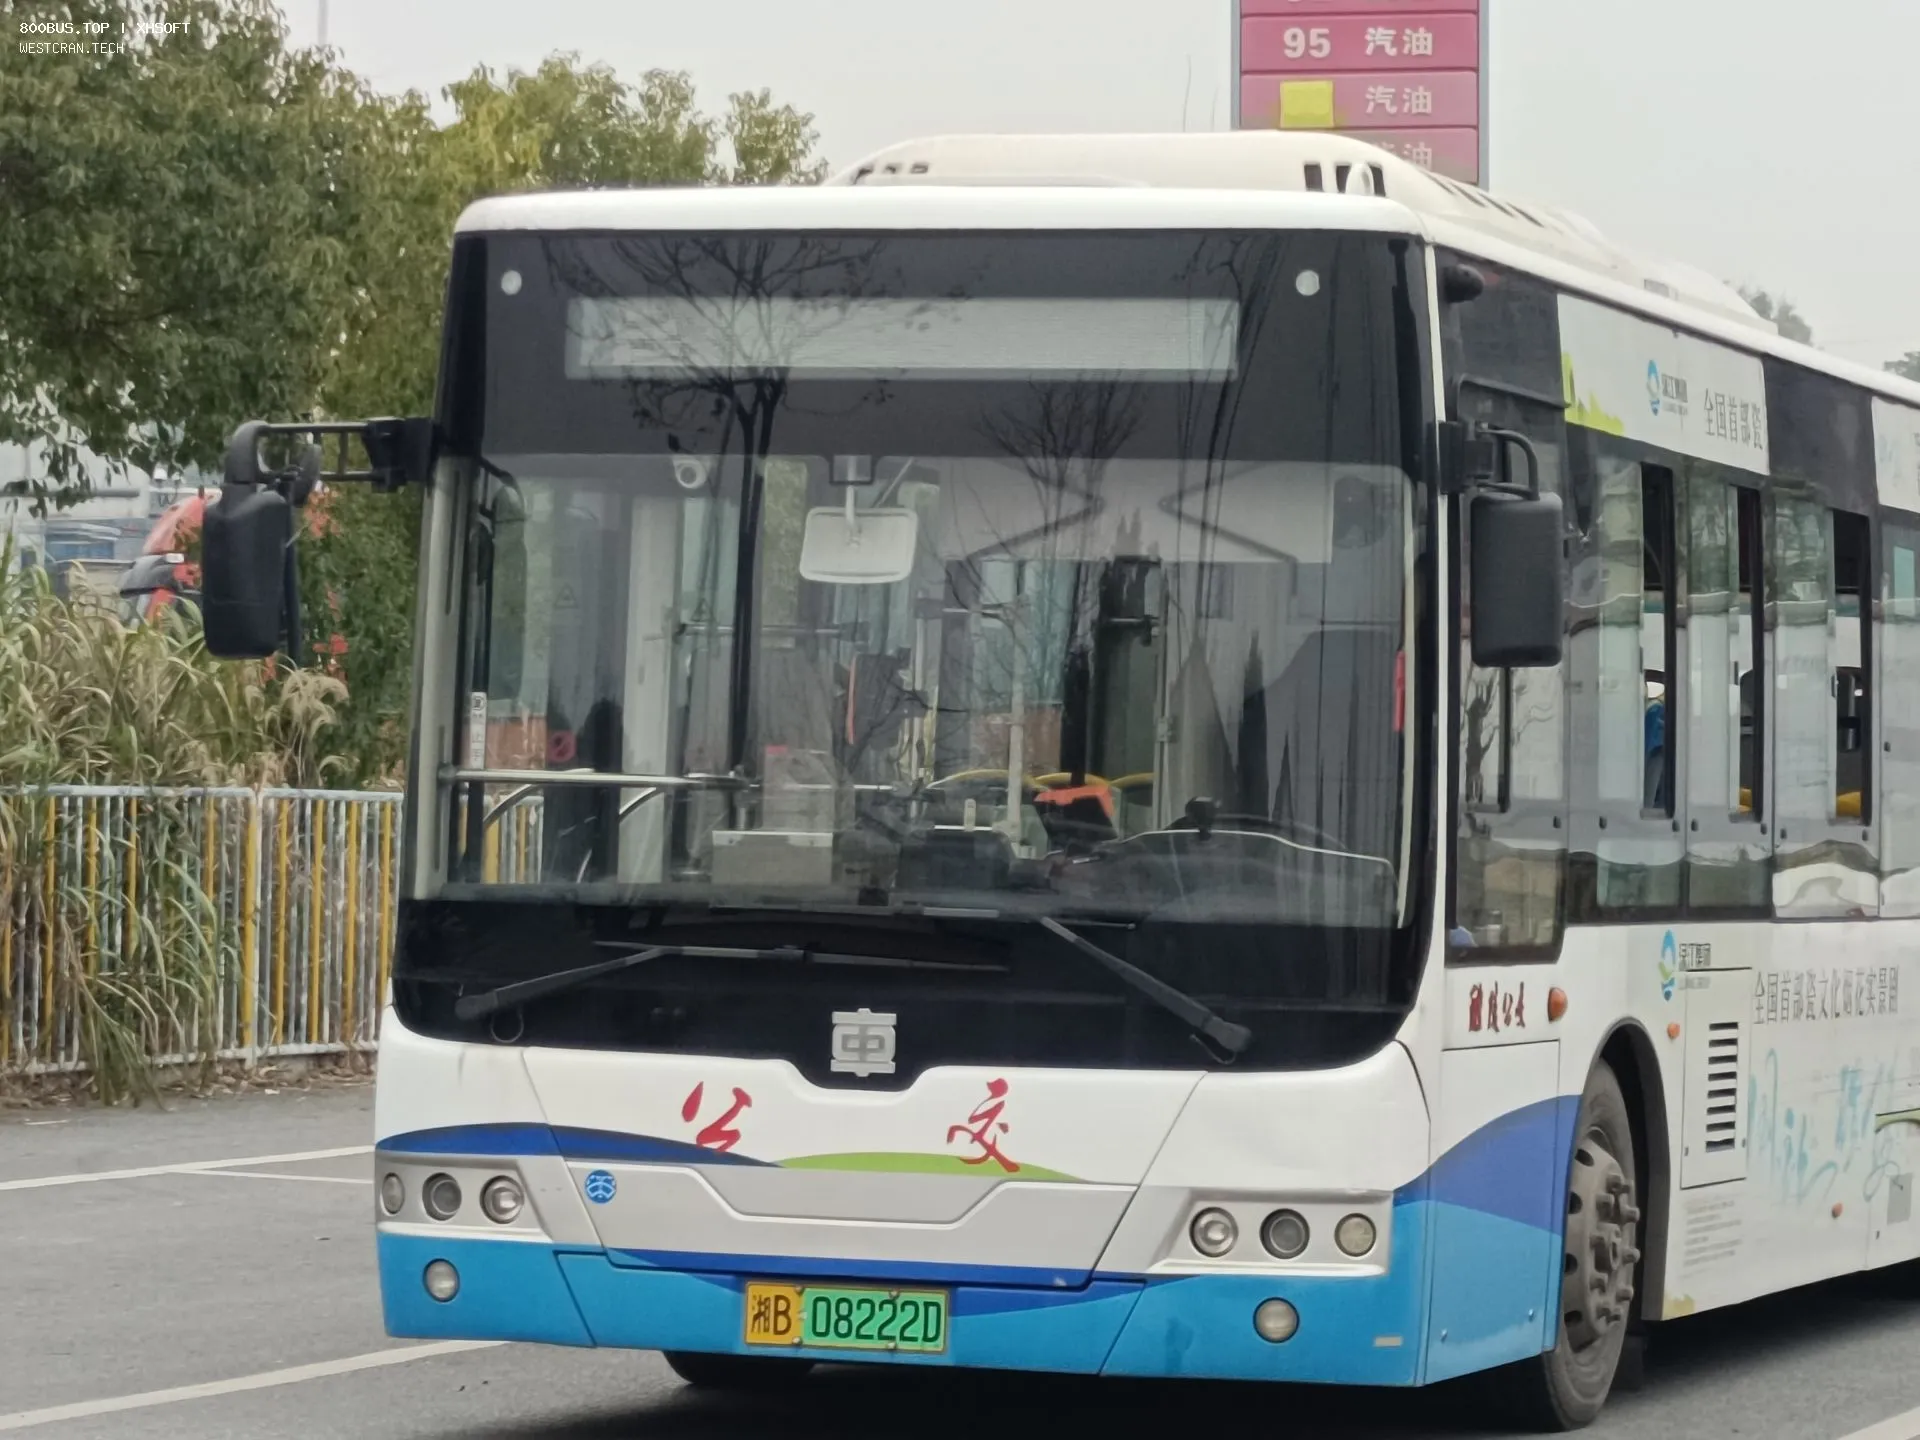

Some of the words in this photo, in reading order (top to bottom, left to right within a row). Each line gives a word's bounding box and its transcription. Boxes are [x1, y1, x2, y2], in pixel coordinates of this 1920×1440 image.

[1283, 27, 1332, 59] 95
[1364, 26, 1434, 57] 汽油
[1365, 85, 1433, 115] 汽油
[751, 1293, 793, 1336] 湘B
[811, 1295, 942, 1343] 08222D
